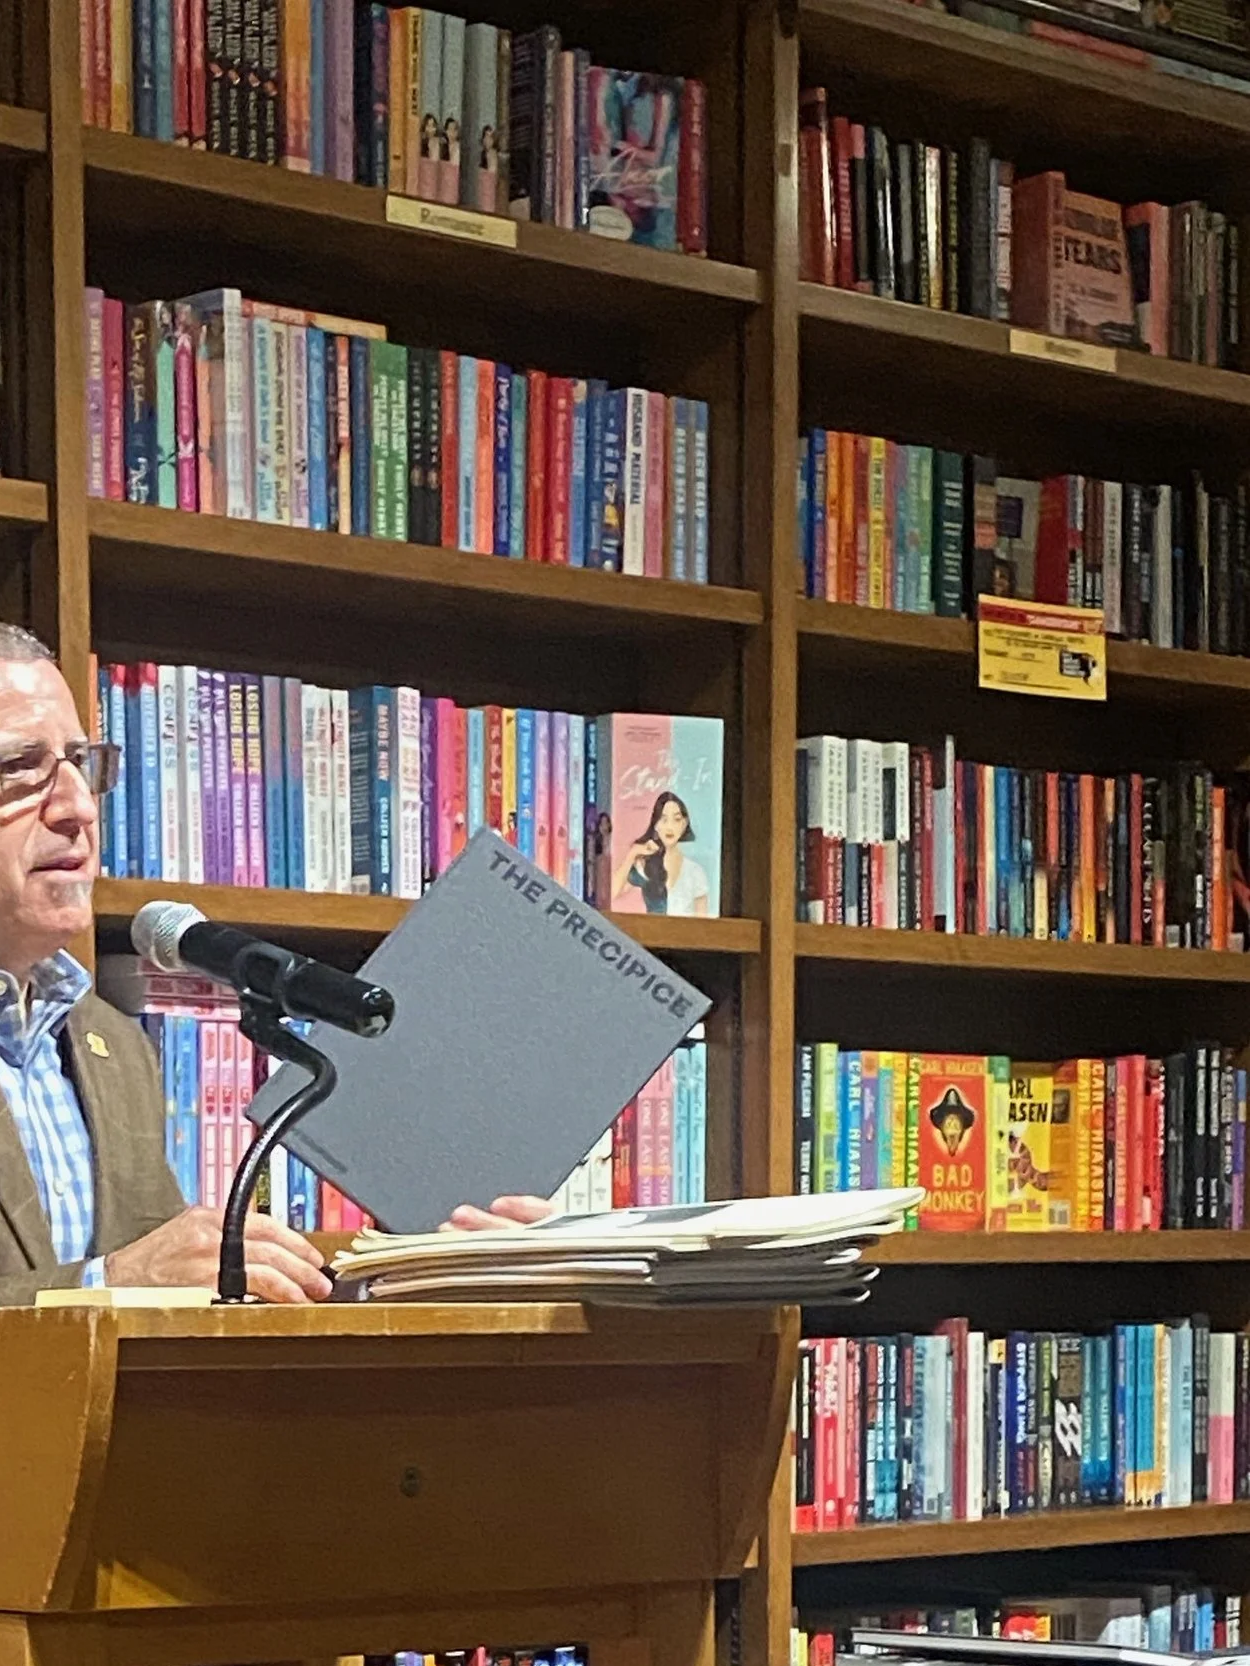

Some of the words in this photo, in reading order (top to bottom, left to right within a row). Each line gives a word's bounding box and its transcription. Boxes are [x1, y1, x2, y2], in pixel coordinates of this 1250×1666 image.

[1065, 236, 1122, 274] TEARS
[631, 392, 643, 448] HUSBAND
[629, 452, 642, 506] MATERIAL
[162, 684, 177, 770] CONFESS
[230, 684, 243, 735] LOSING
[246, 684, 260, 735] LOSING
[376, 704, 390, 748] MAYBE
[377, 751, 390, 781] NOW
[620, 755, 715, 800] Stand-In
[379, 797, 390, 835] COLLEEN
[380, 836, 391, 873] HOOVER
[488, 850, 548, 904] THE
[547, 899, 694, 1020] PRECIPICE
[849, 1060, 861, 1108] CARL
[909, 1056, 919, 1109] CARL
[1091, 1062, 1104, 1114] CARL
[639, 1099, 652, 1127] ONE
[640, 1135, 652, 1171] LAST
[659, 1135, 671, 1171] LAST
[932, 1163, 973, 1188] BAD
[1091, 1129, 1104, 1217] HIAASEN
[919, 1190, 986, 1213] MONKEY
